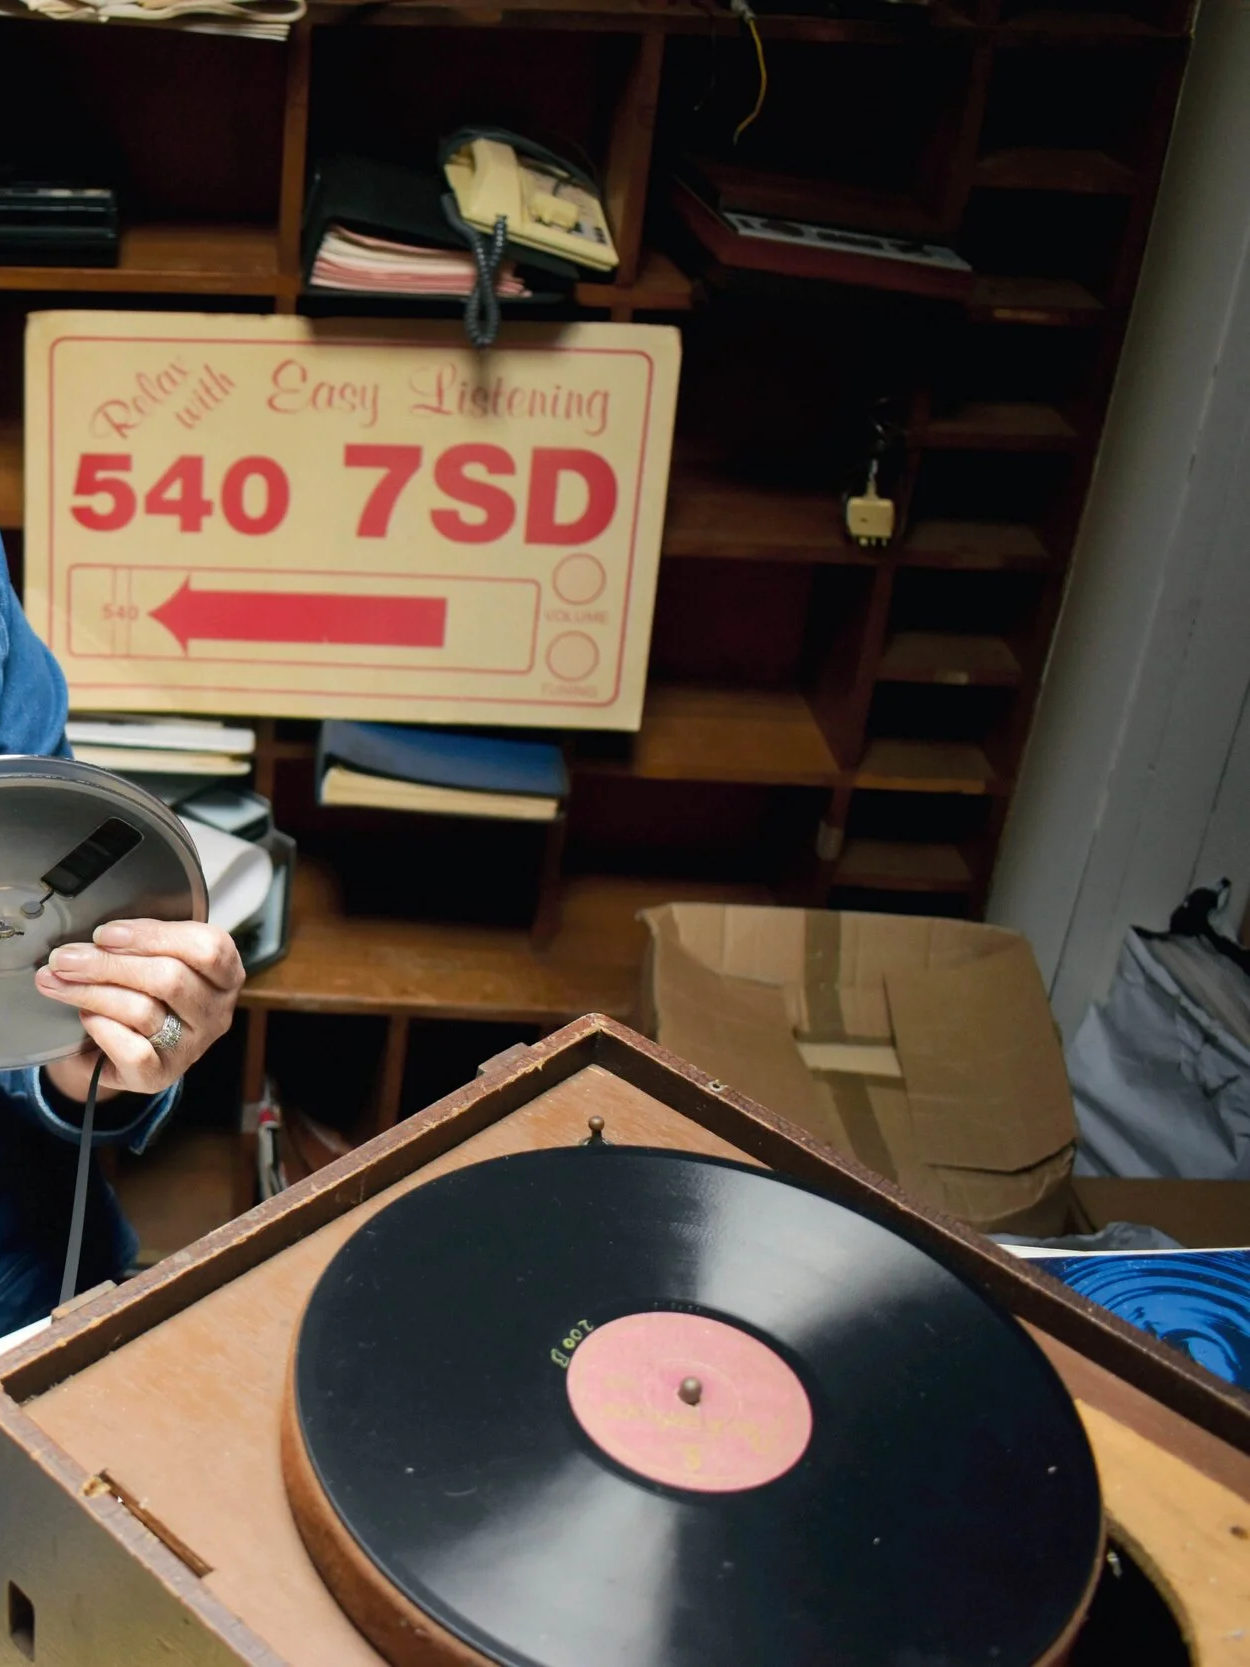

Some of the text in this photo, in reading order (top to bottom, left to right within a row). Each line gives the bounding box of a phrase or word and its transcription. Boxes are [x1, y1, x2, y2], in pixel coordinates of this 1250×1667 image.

[175, 363, 237, 430] with
[266, 359, 610, 436] Easy Listening
[69, 442, 618, 546] 540 7SD
[102, 603, 139, 622] 540
[544, 609, 609, 625] VOLUME
